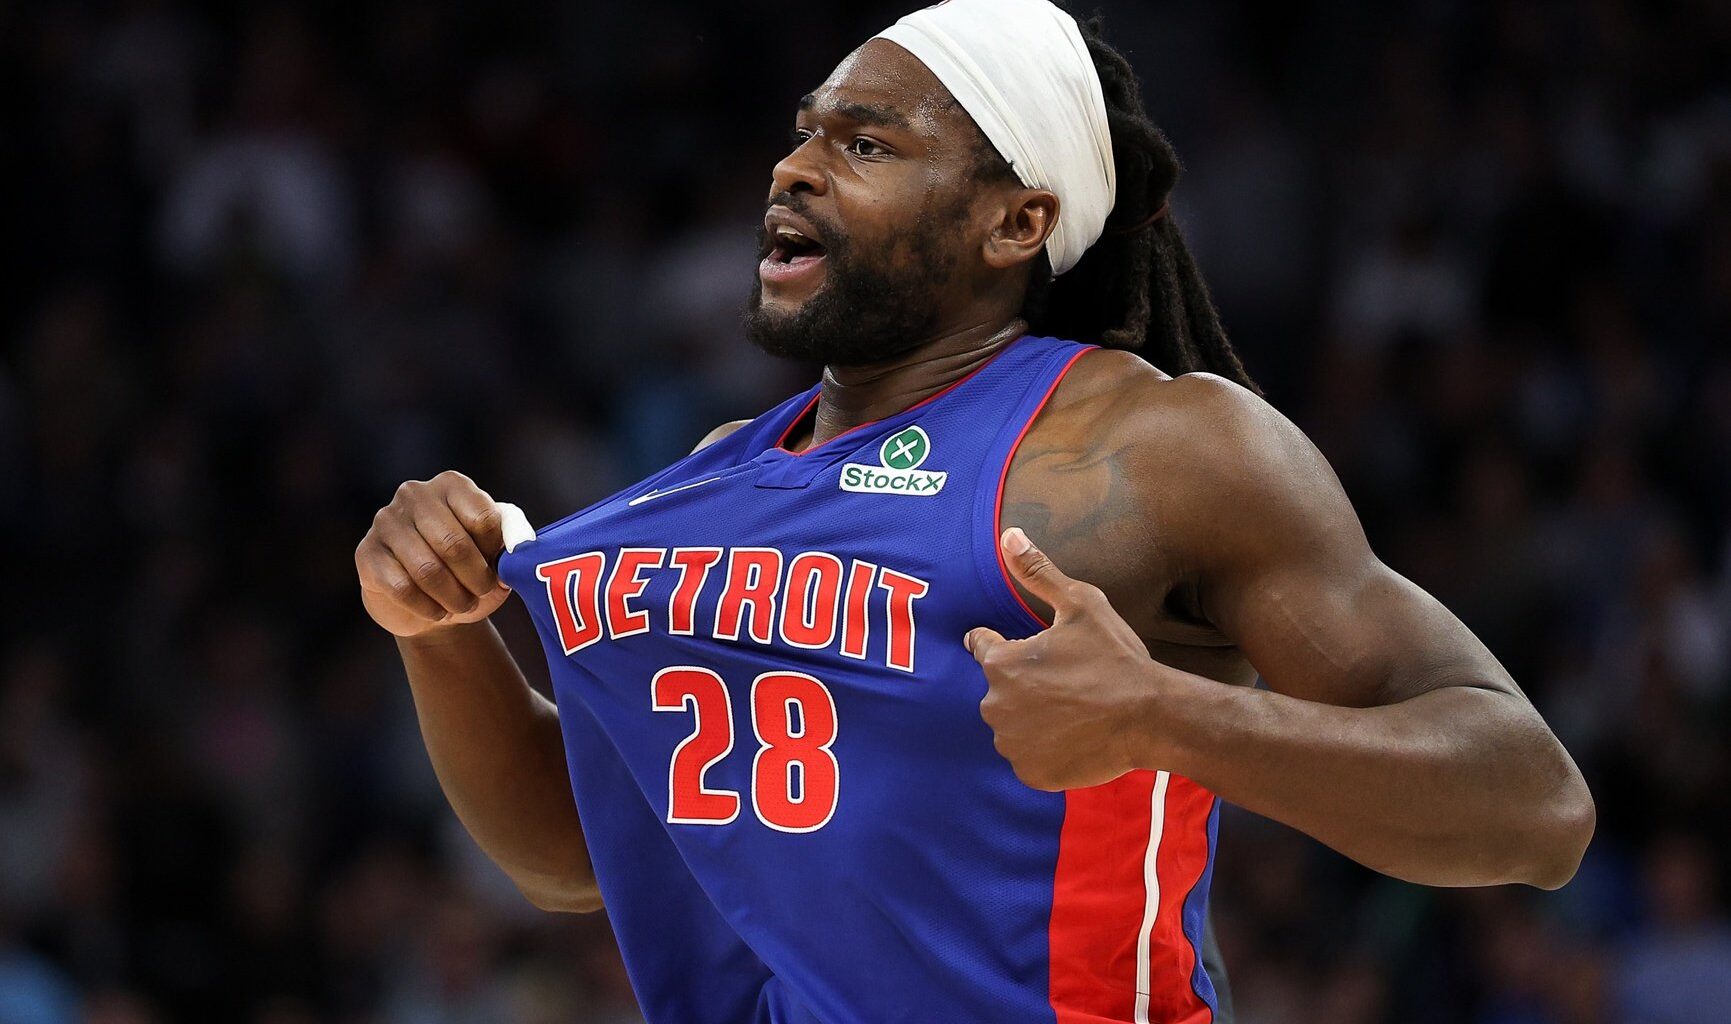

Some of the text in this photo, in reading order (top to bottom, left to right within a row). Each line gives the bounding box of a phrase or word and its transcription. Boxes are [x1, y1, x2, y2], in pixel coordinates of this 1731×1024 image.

[844, 467, 944, 492] StockX
[536, 547, 929, 672] DETROIT
[651, 666, 839, 833] 28
